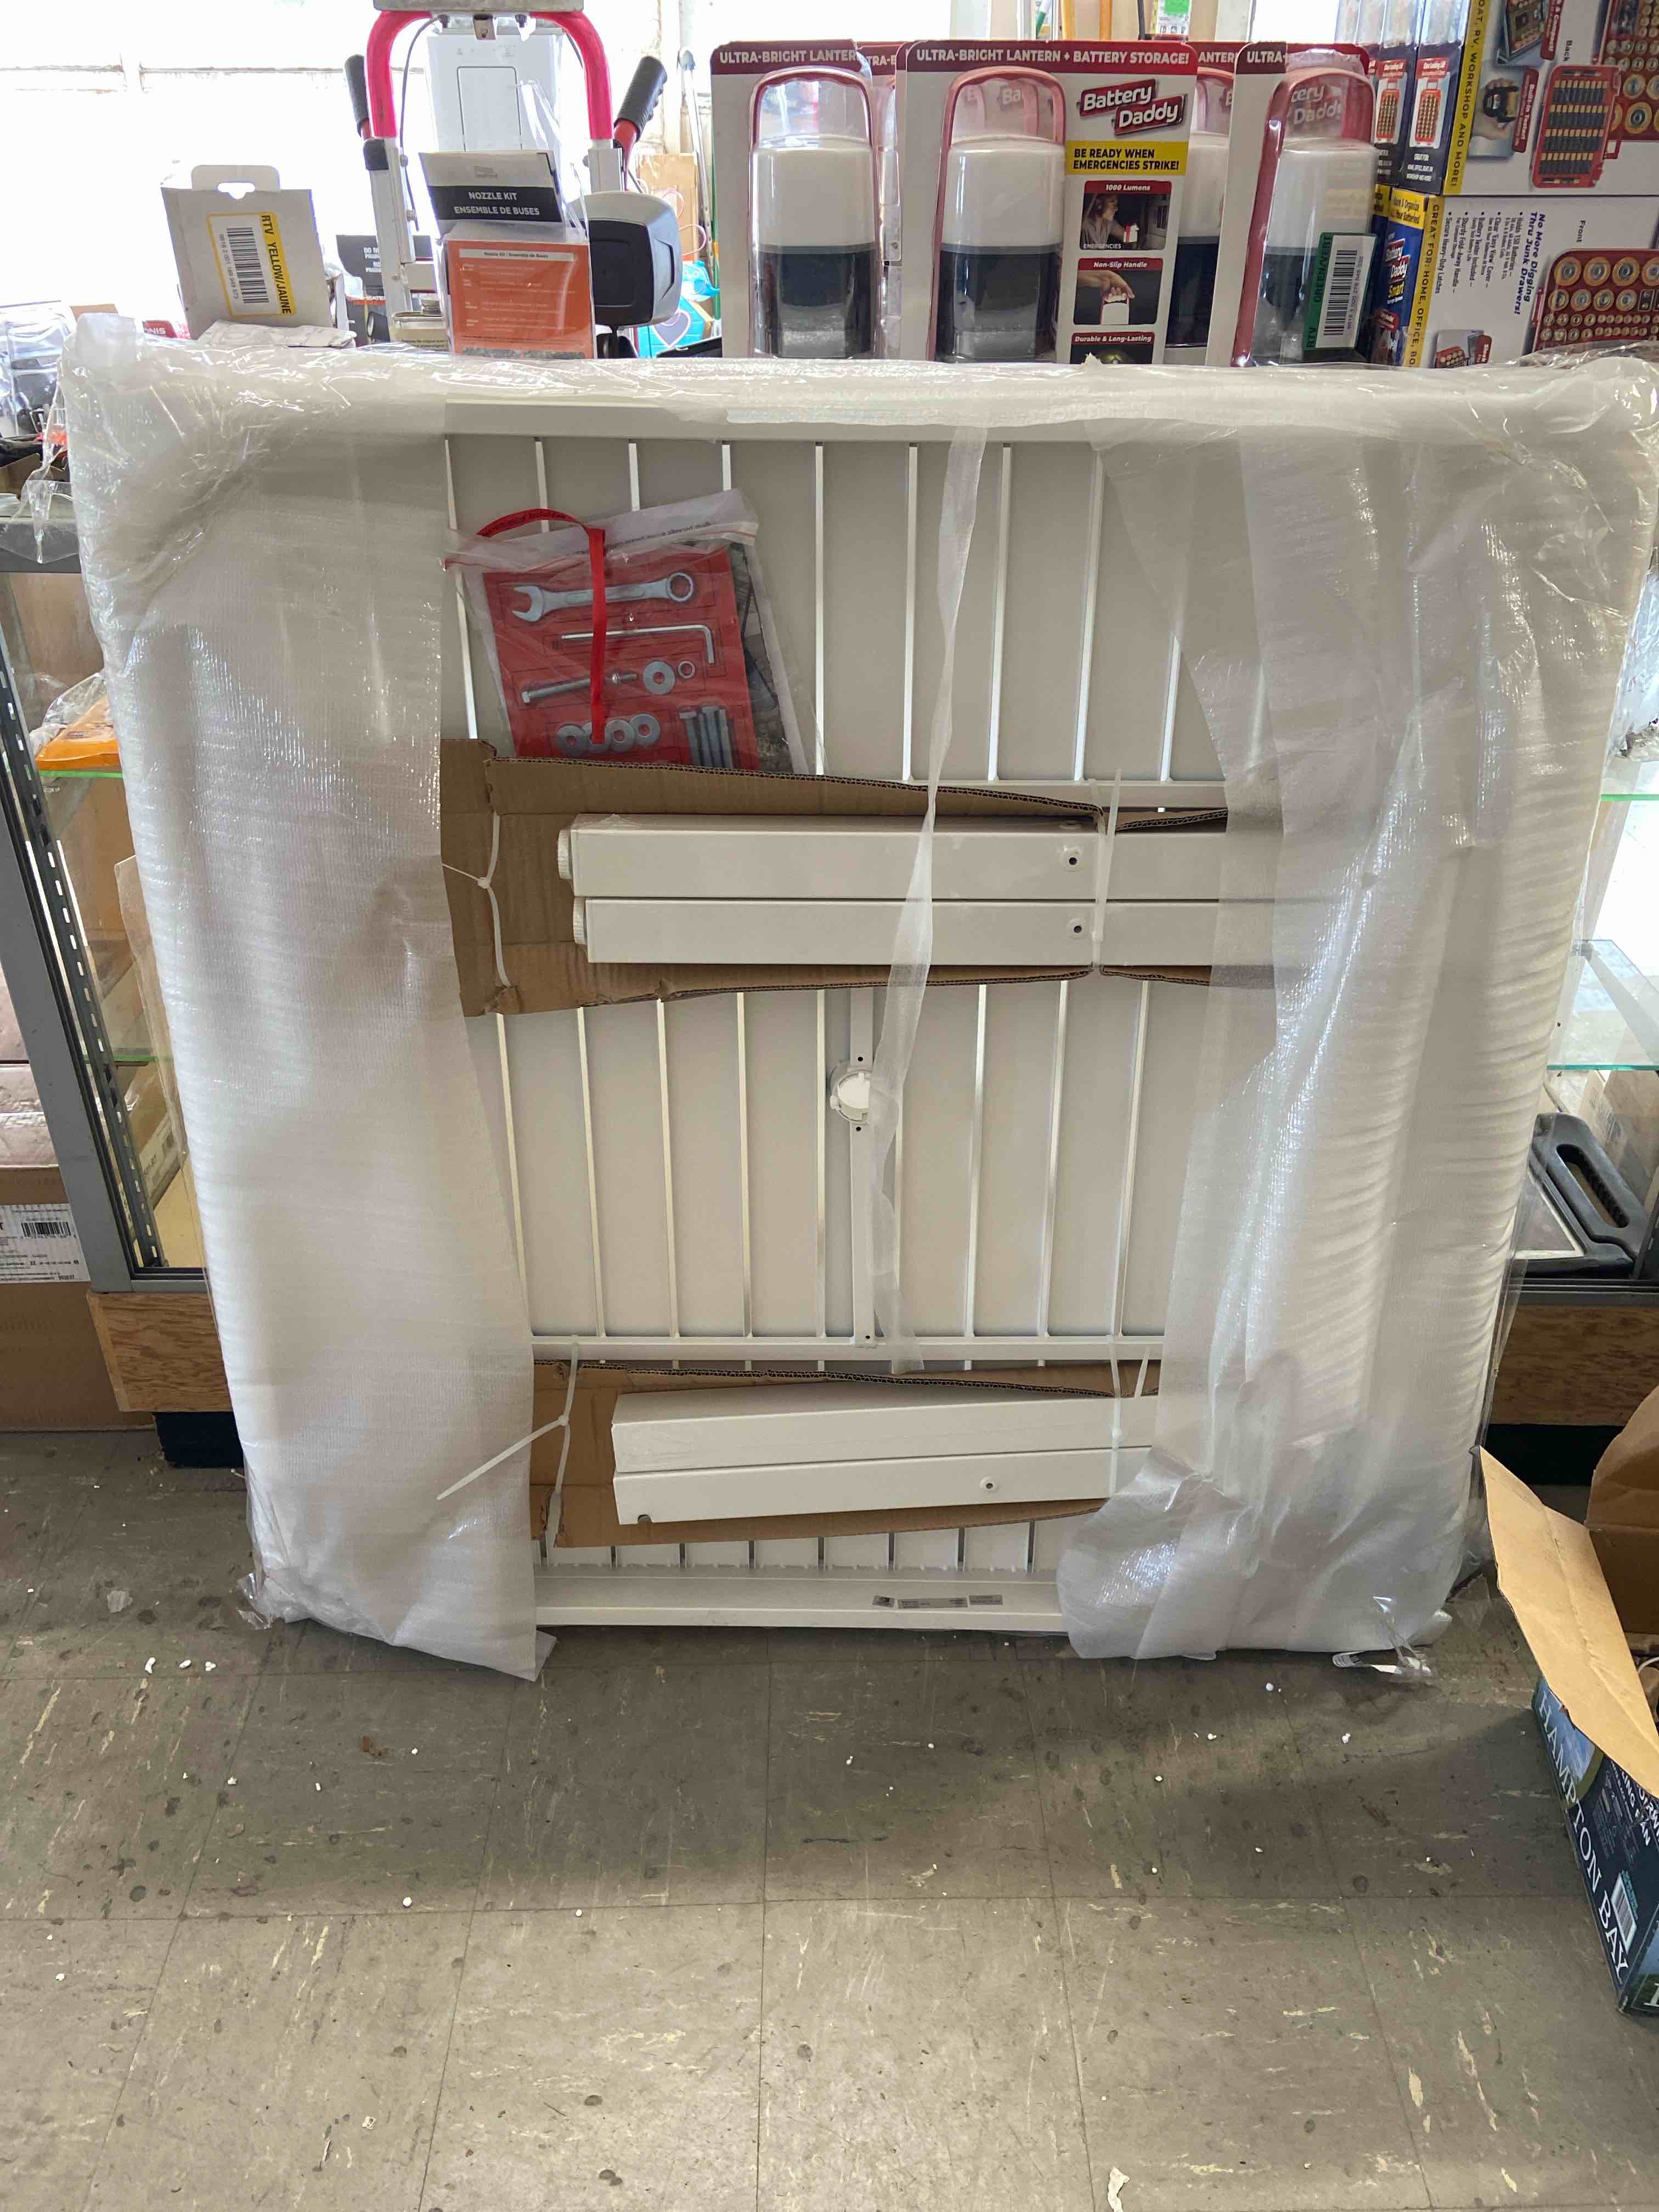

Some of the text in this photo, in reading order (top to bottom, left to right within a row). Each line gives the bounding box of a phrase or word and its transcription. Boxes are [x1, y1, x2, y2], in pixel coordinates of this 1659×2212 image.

[1471, 30, 1481, 47] RV,
[1563, 40, 1573, 61] Back
[720, 50, 859, 64] ULTRA-BRIGHT LANTER
[917, 49, 1004, 61] ULTRA-BRIGHT
[1007, 50, 1060, 62] LANTERN
[1073, 50, 1127, 63] BATTERY
[1130, 52, 1189, 64] STORAGE!
[1198, 52, 1235, 63] ANTER
[1462, 52, 1479, 119] WORKSHOP
[1084, 86, 1153, 111] Battery
[1119, 101, 1178, 128] Daddy
[1457, 123, 1466, 146] AND
[1073, 160, 1179, 170] EMERGENCIES STRIKE!
[1074, 149, 1155, 158] BE READY WHEN
[1451, 151, 1462, 185] MORE!
[468, 191, 503, 200] NOZZLE
[513, 207, 540, 215] BUSES
[1429, 204, 1439, 238] GREAT
[1576, 220, 1585, 242] Front
[1425, 242, 1434, 267] FOR:
[1435, 217, 1452, 294] Secure Heavy-Duty Latches
[1452, 217, 1469, 287] Sturdy Fold-Away Handle
[1514, 212, 1537, 315] Thru Junk Drawers!
[1524, 213, 1545, 302] No More Digging
[261, 215, 291, 314] RTV YELLOW/JAUNE
[1391, 260, 1407, 278] Daddy
[1469, 257, 1480, 281] Included
[1485, 266, 1493, 282] Cover
[1419, 270, 1431, 303] HOME,
[1412, 308, 1424, 346] OFFICE,
[1539, 1690, 1602, 1893] HAMPTON
[1599, 1890, 1628, 1985] BAY
